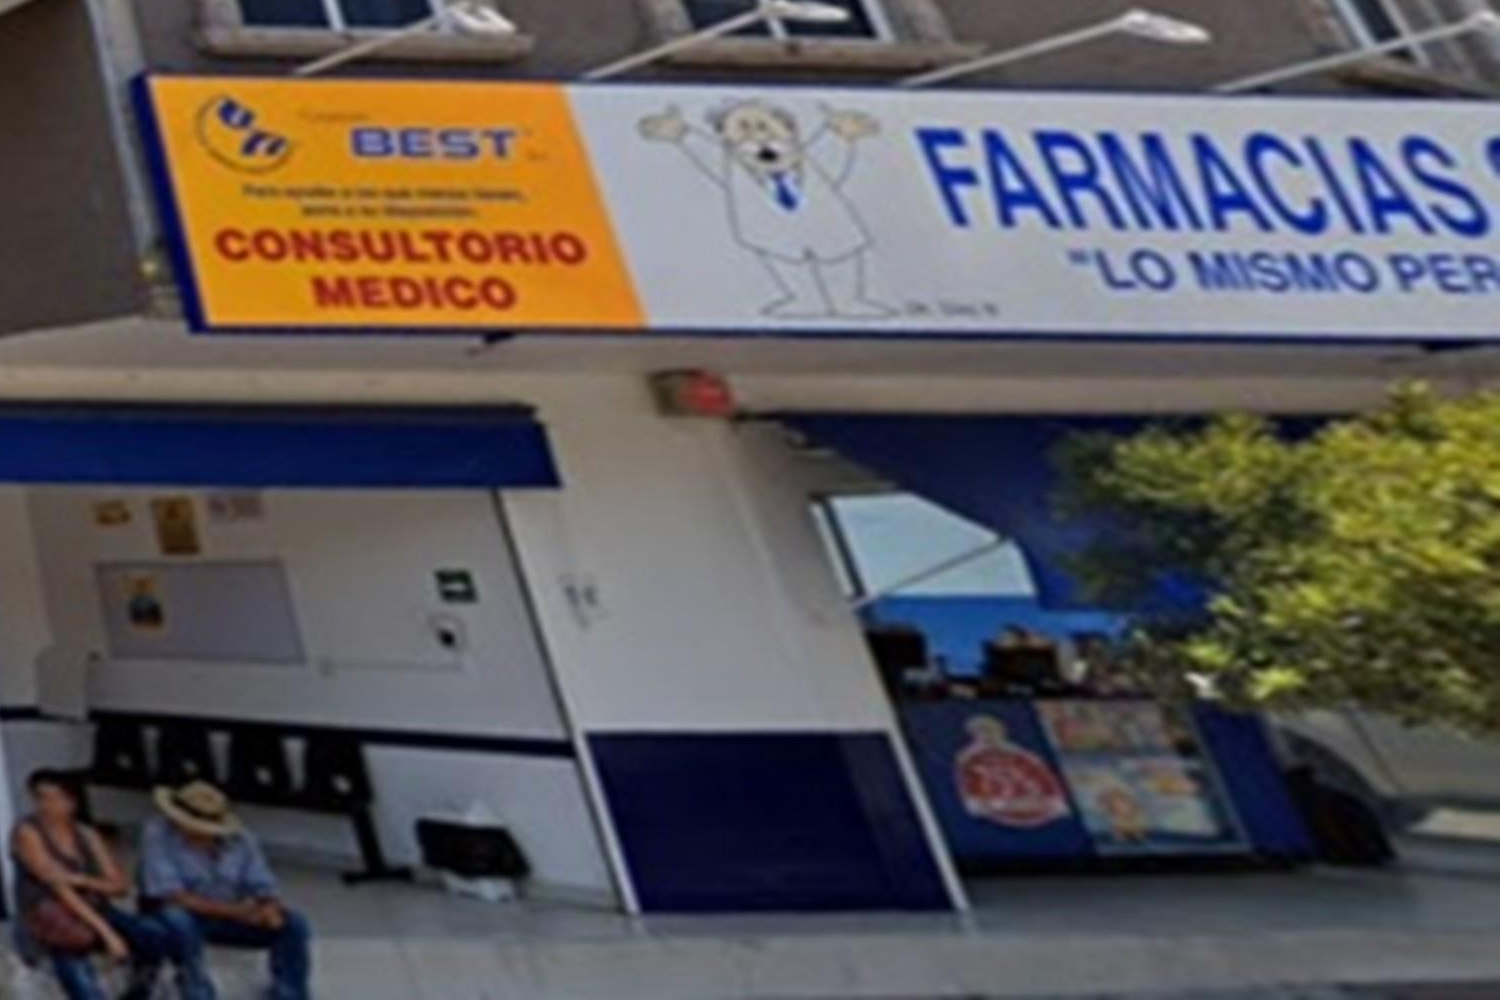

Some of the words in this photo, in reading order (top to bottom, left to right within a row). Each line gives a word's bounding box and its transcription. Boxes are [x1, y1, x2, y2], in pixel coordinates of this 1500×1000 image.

[351, 126, 517, 160] BEST
[914, 126, 1491, 238] FARMACIAS
[214, 228, 588, 266] CONSULTORIO
[1187, 251, 1380, 293] MISMO
[312, 275, 517, 311] MEDICO
